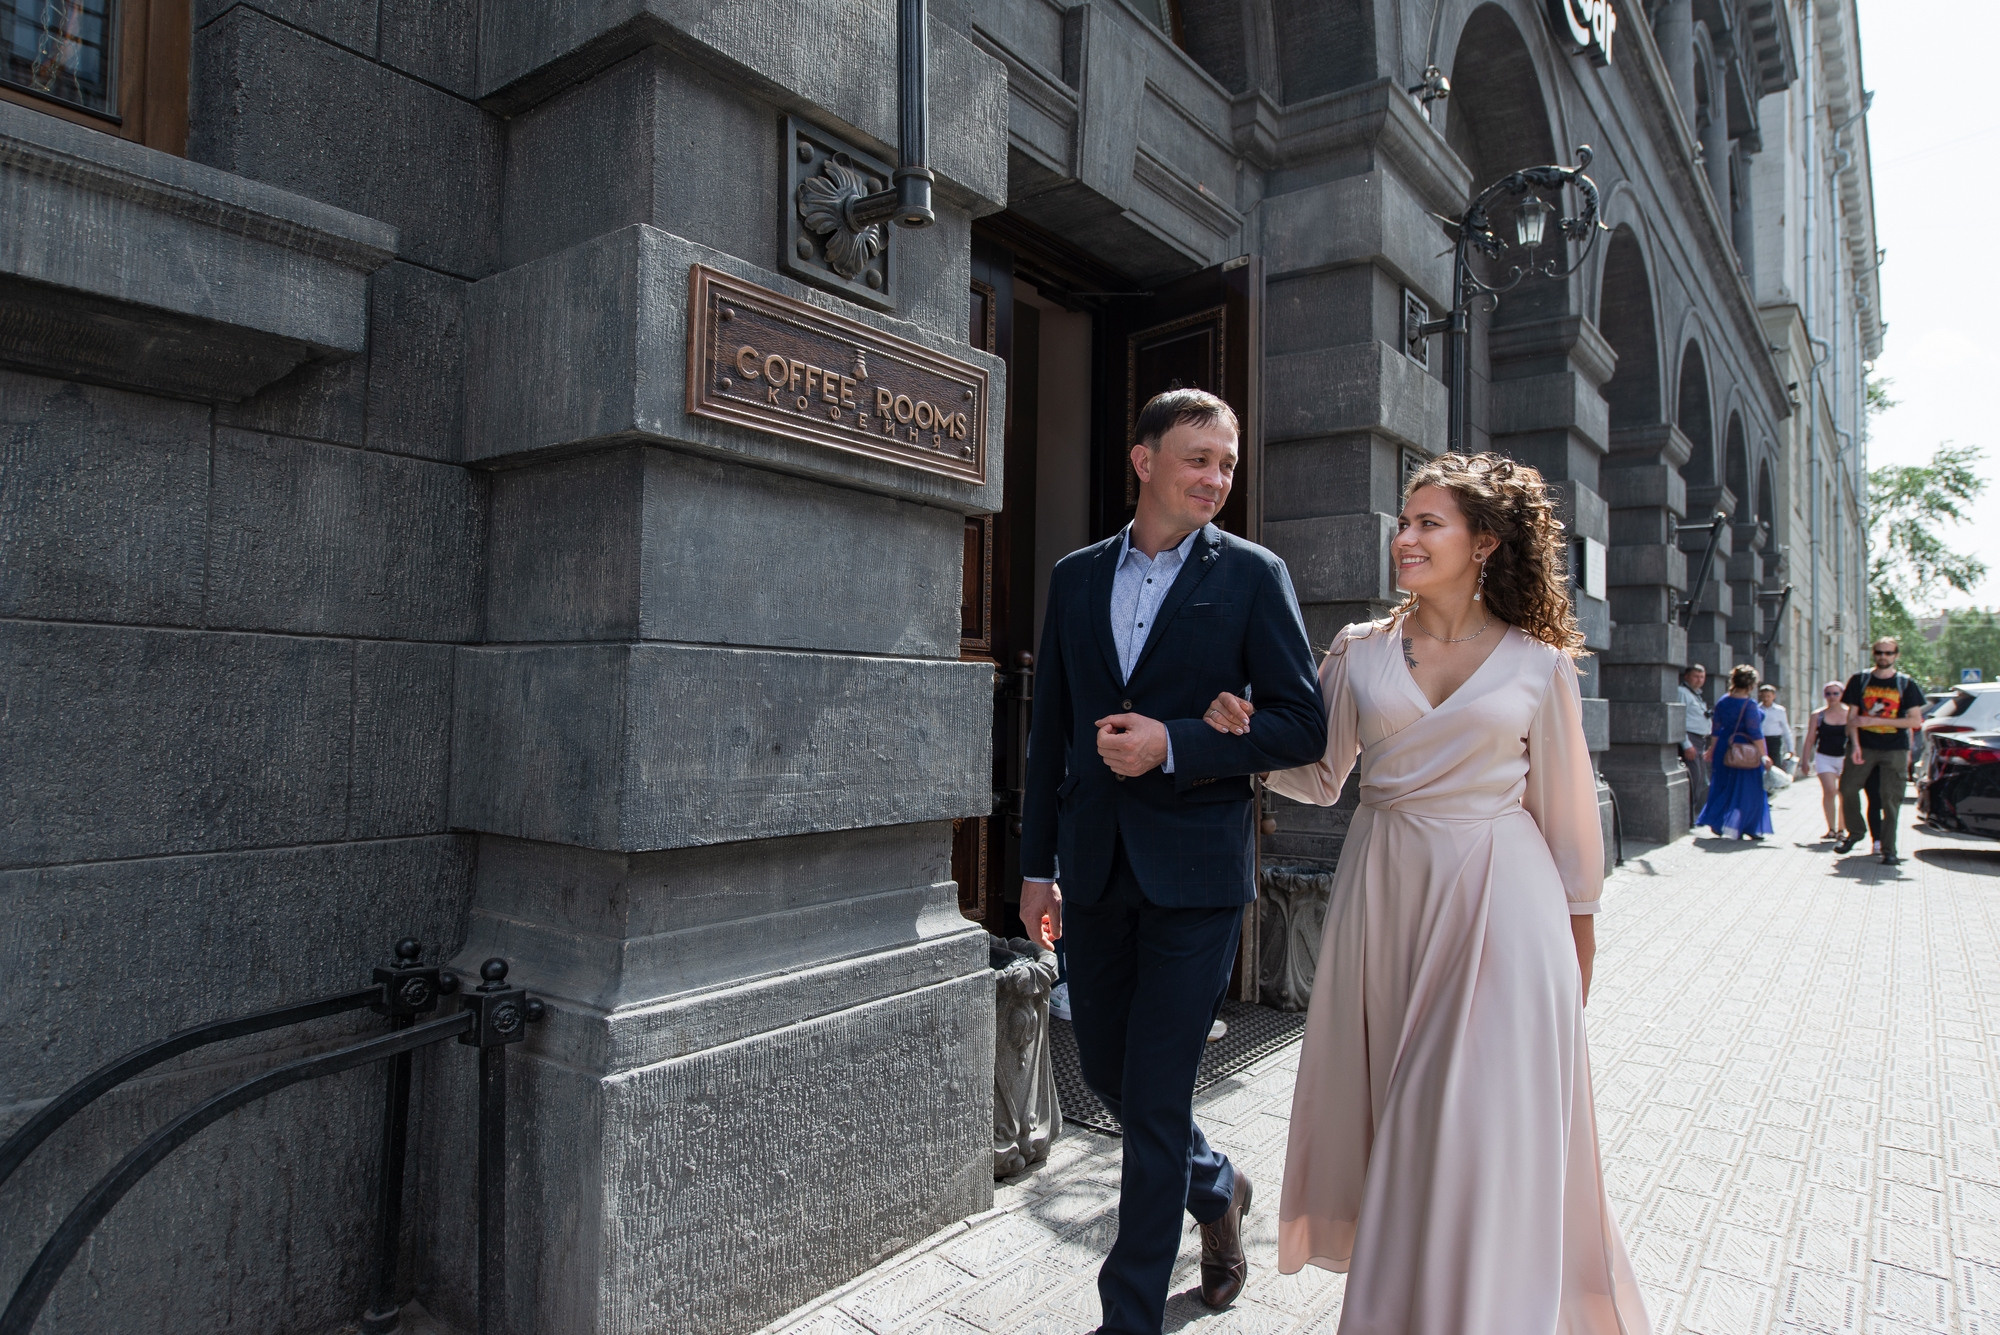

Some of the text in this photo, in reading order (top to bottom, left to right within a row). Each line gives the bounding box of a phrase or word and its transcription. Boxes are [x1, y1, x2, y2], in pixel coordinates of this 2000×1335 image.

[736, 346, 967, 440] COFFEE ROOMS
[767, 386, 941, 449] КОФЕЙНЯ
